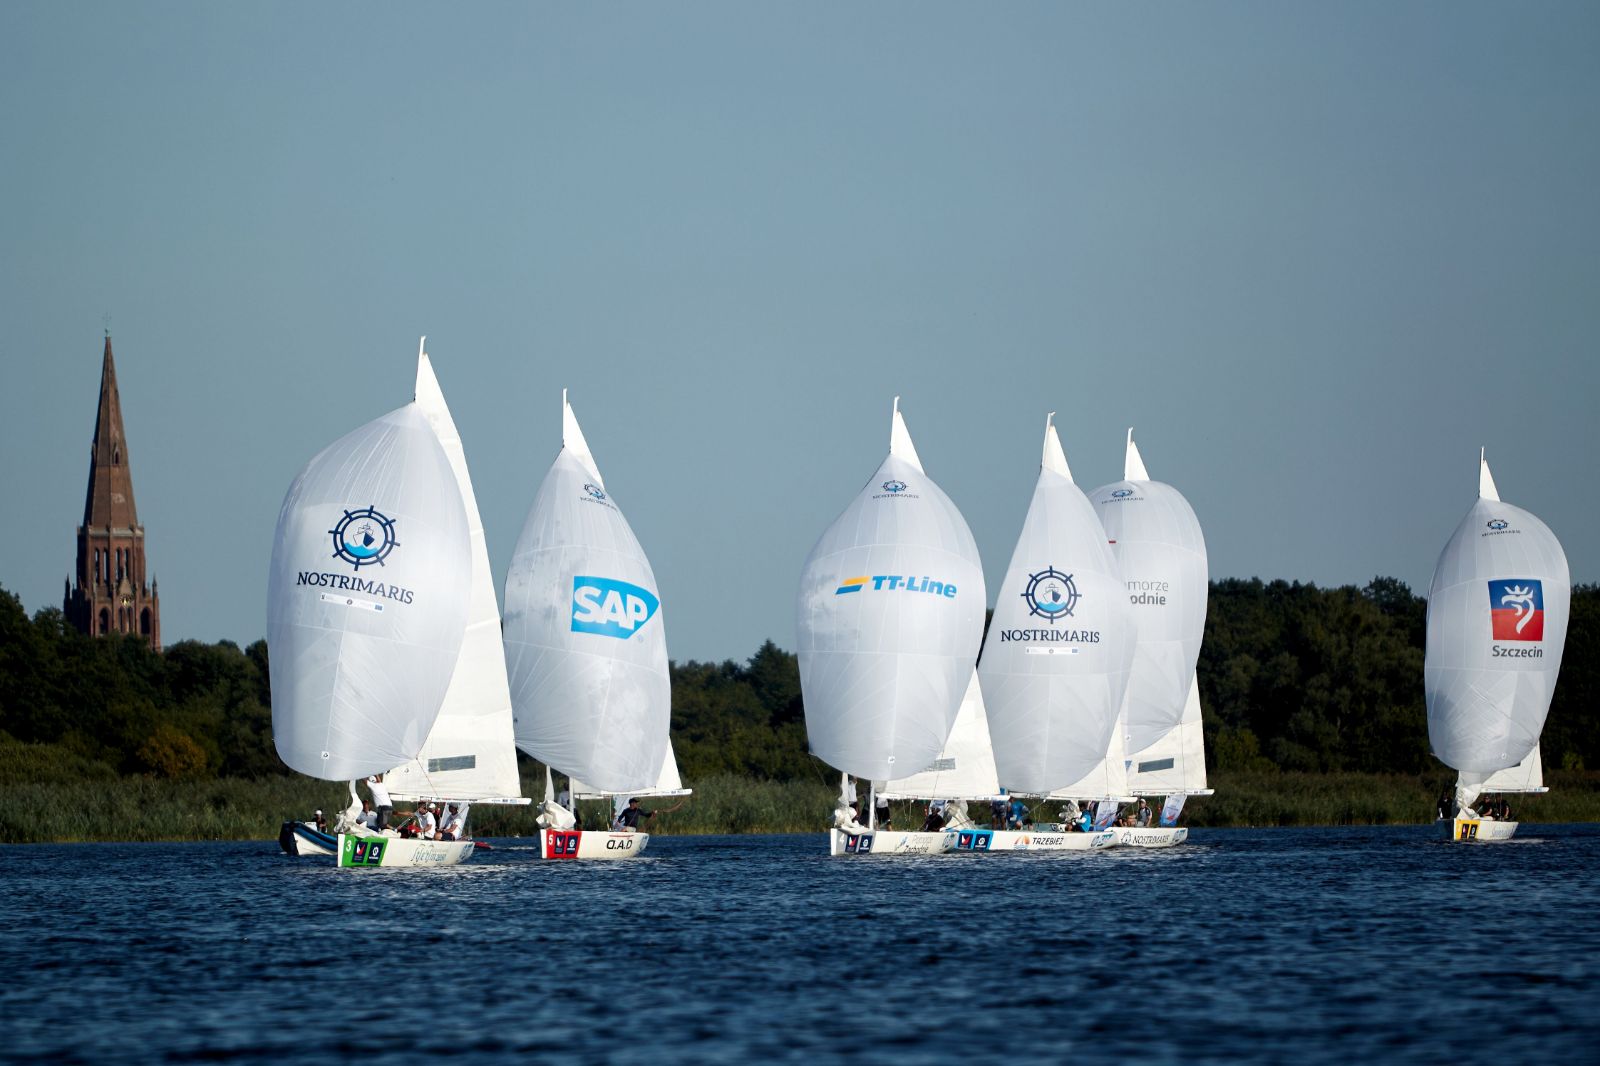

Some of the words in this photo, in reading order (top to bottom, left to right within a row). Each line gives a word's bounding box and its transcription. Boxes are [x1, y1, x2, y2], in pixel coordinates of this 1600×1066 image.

[296, 571, 414, 605] NOSTRIMARIS
[871, 575, 958, 599] TT-Line
[1126, 580, 1169, 592] morze
[1129, 592, 1167, 605] odnie
[573, 585, 648, 631] SAP
[1000, 629, 1100, 644] NOSTRIMARIS
[1492, 645, 1543, 659] Szczecin
[345, 840, 351, 852] 3
[548, 834, 554, 846] 5
